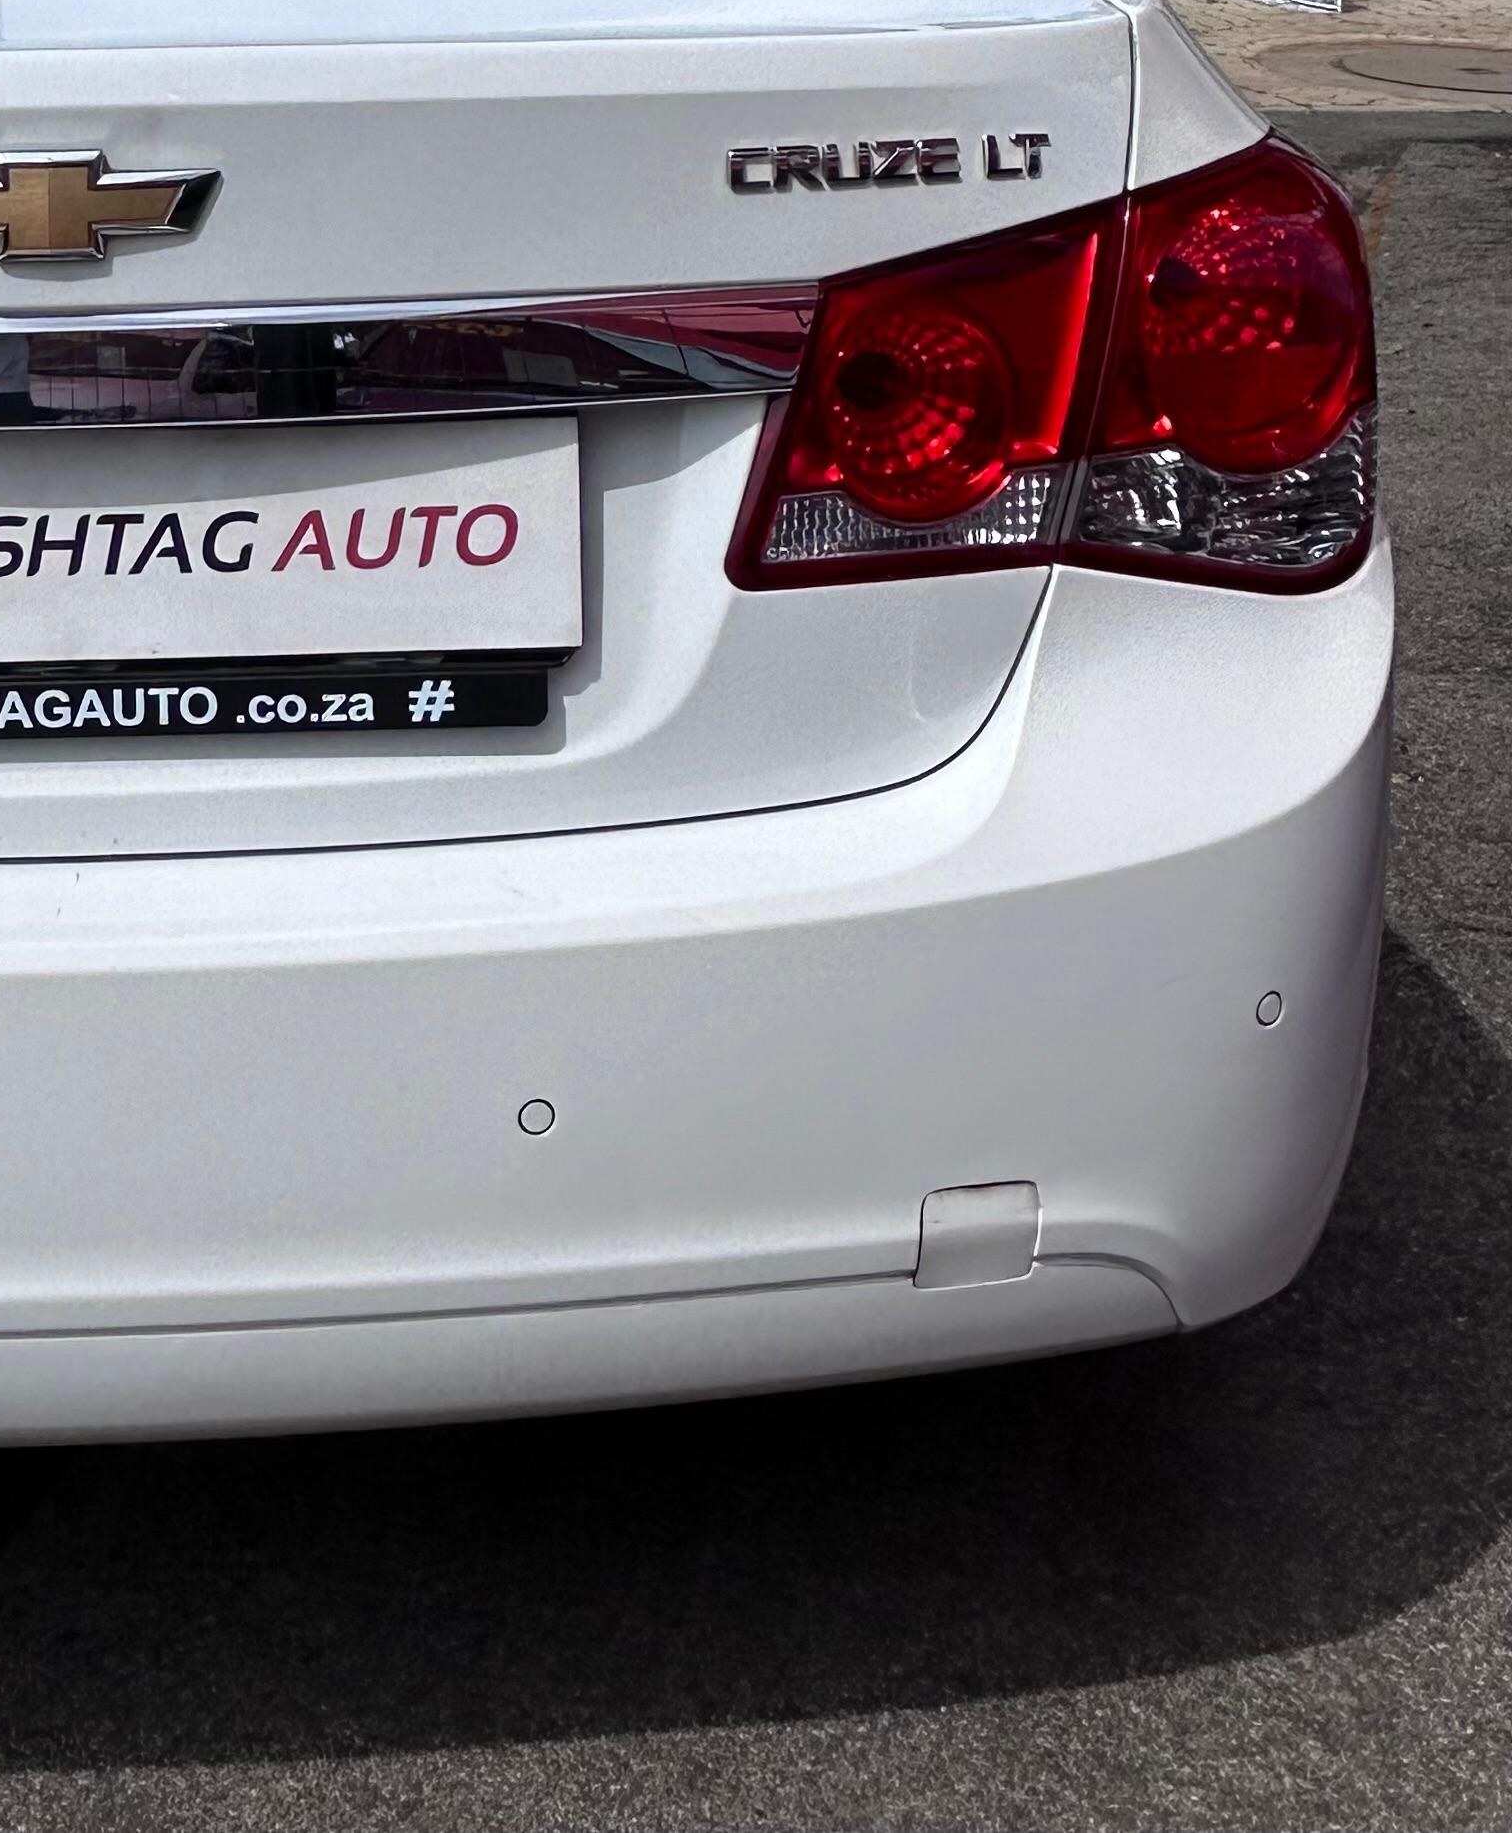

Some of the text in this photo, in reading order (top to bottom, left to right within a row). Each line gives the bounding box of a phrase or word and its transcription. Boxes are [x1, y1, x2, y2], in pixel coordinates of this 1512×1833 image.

[727, 132, 1052, 195] CRUZE LT
[271, 503, 518, 572] AUTO
[236, 691, 375, 724] .co.za
